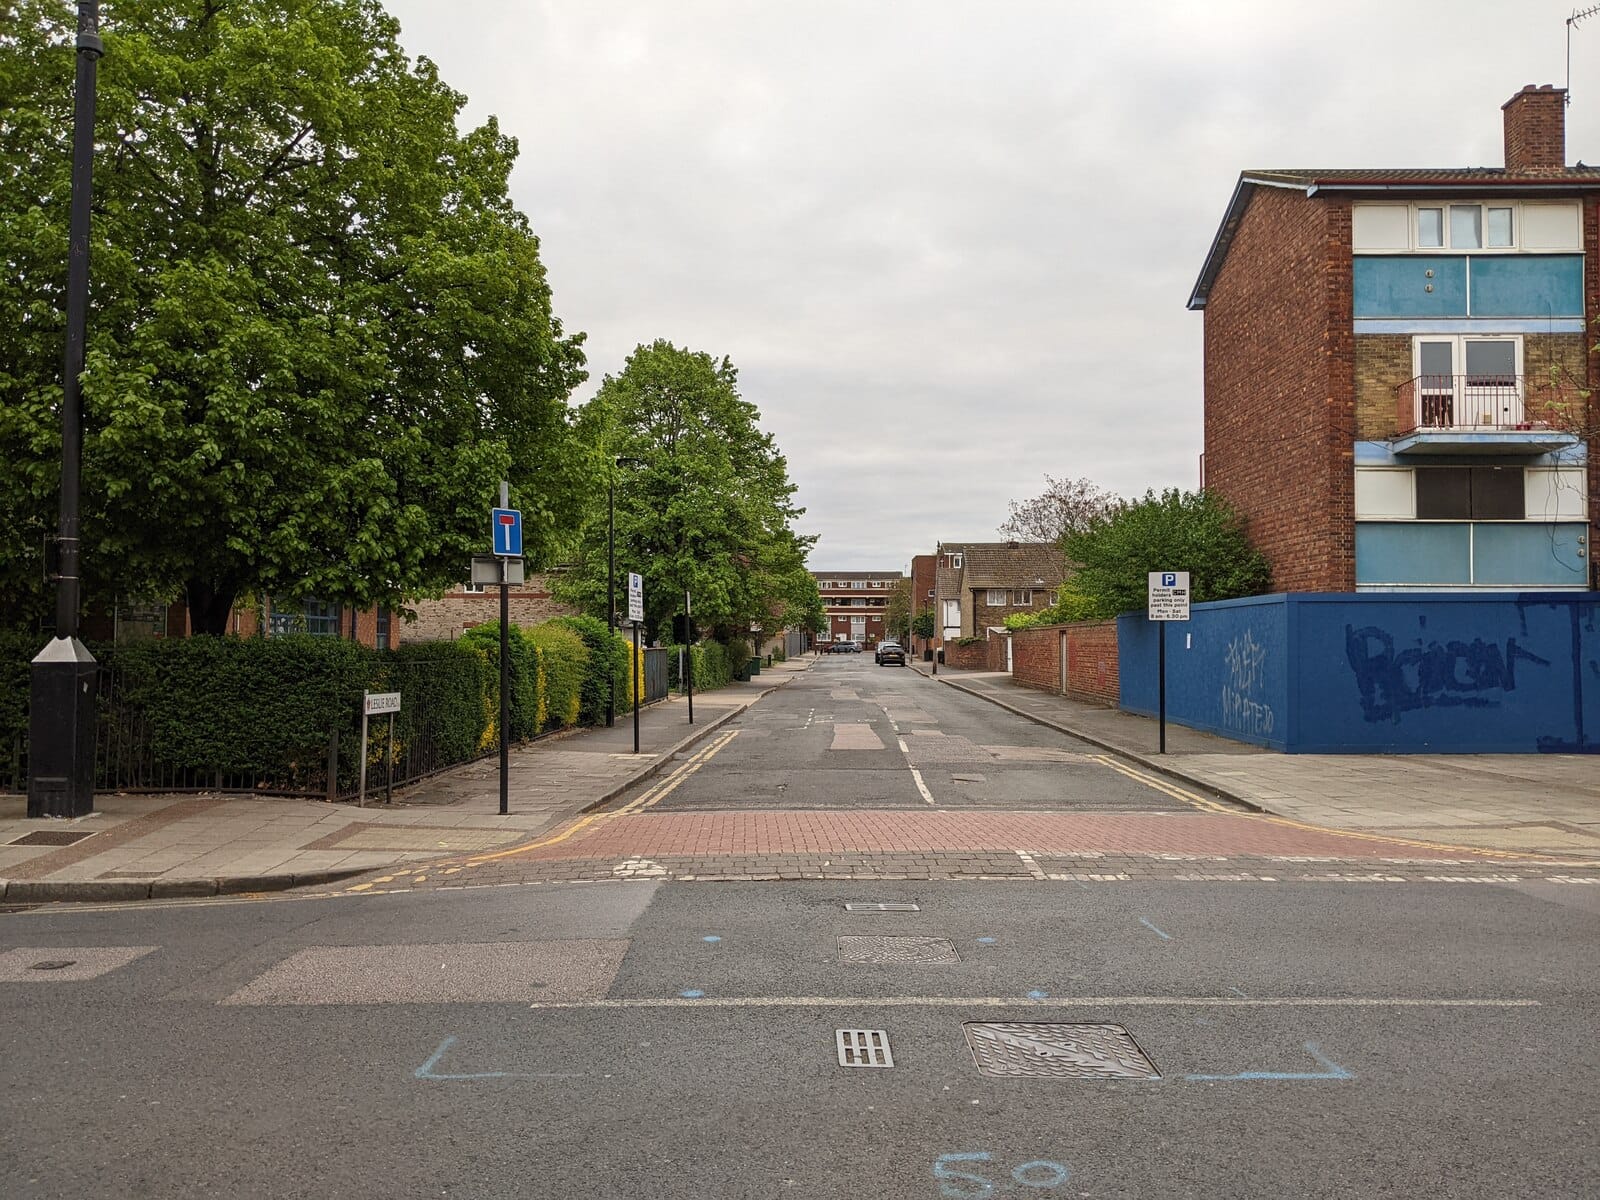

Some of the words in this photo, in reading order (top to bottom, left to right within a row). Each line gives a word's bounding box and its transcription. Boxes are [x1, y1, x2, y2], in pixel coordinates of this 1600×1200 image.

[1165, 574, 1174, 586] P
[371, 698, 385, 709] LESLIE
[386, 696, 397, 707] ROAD
